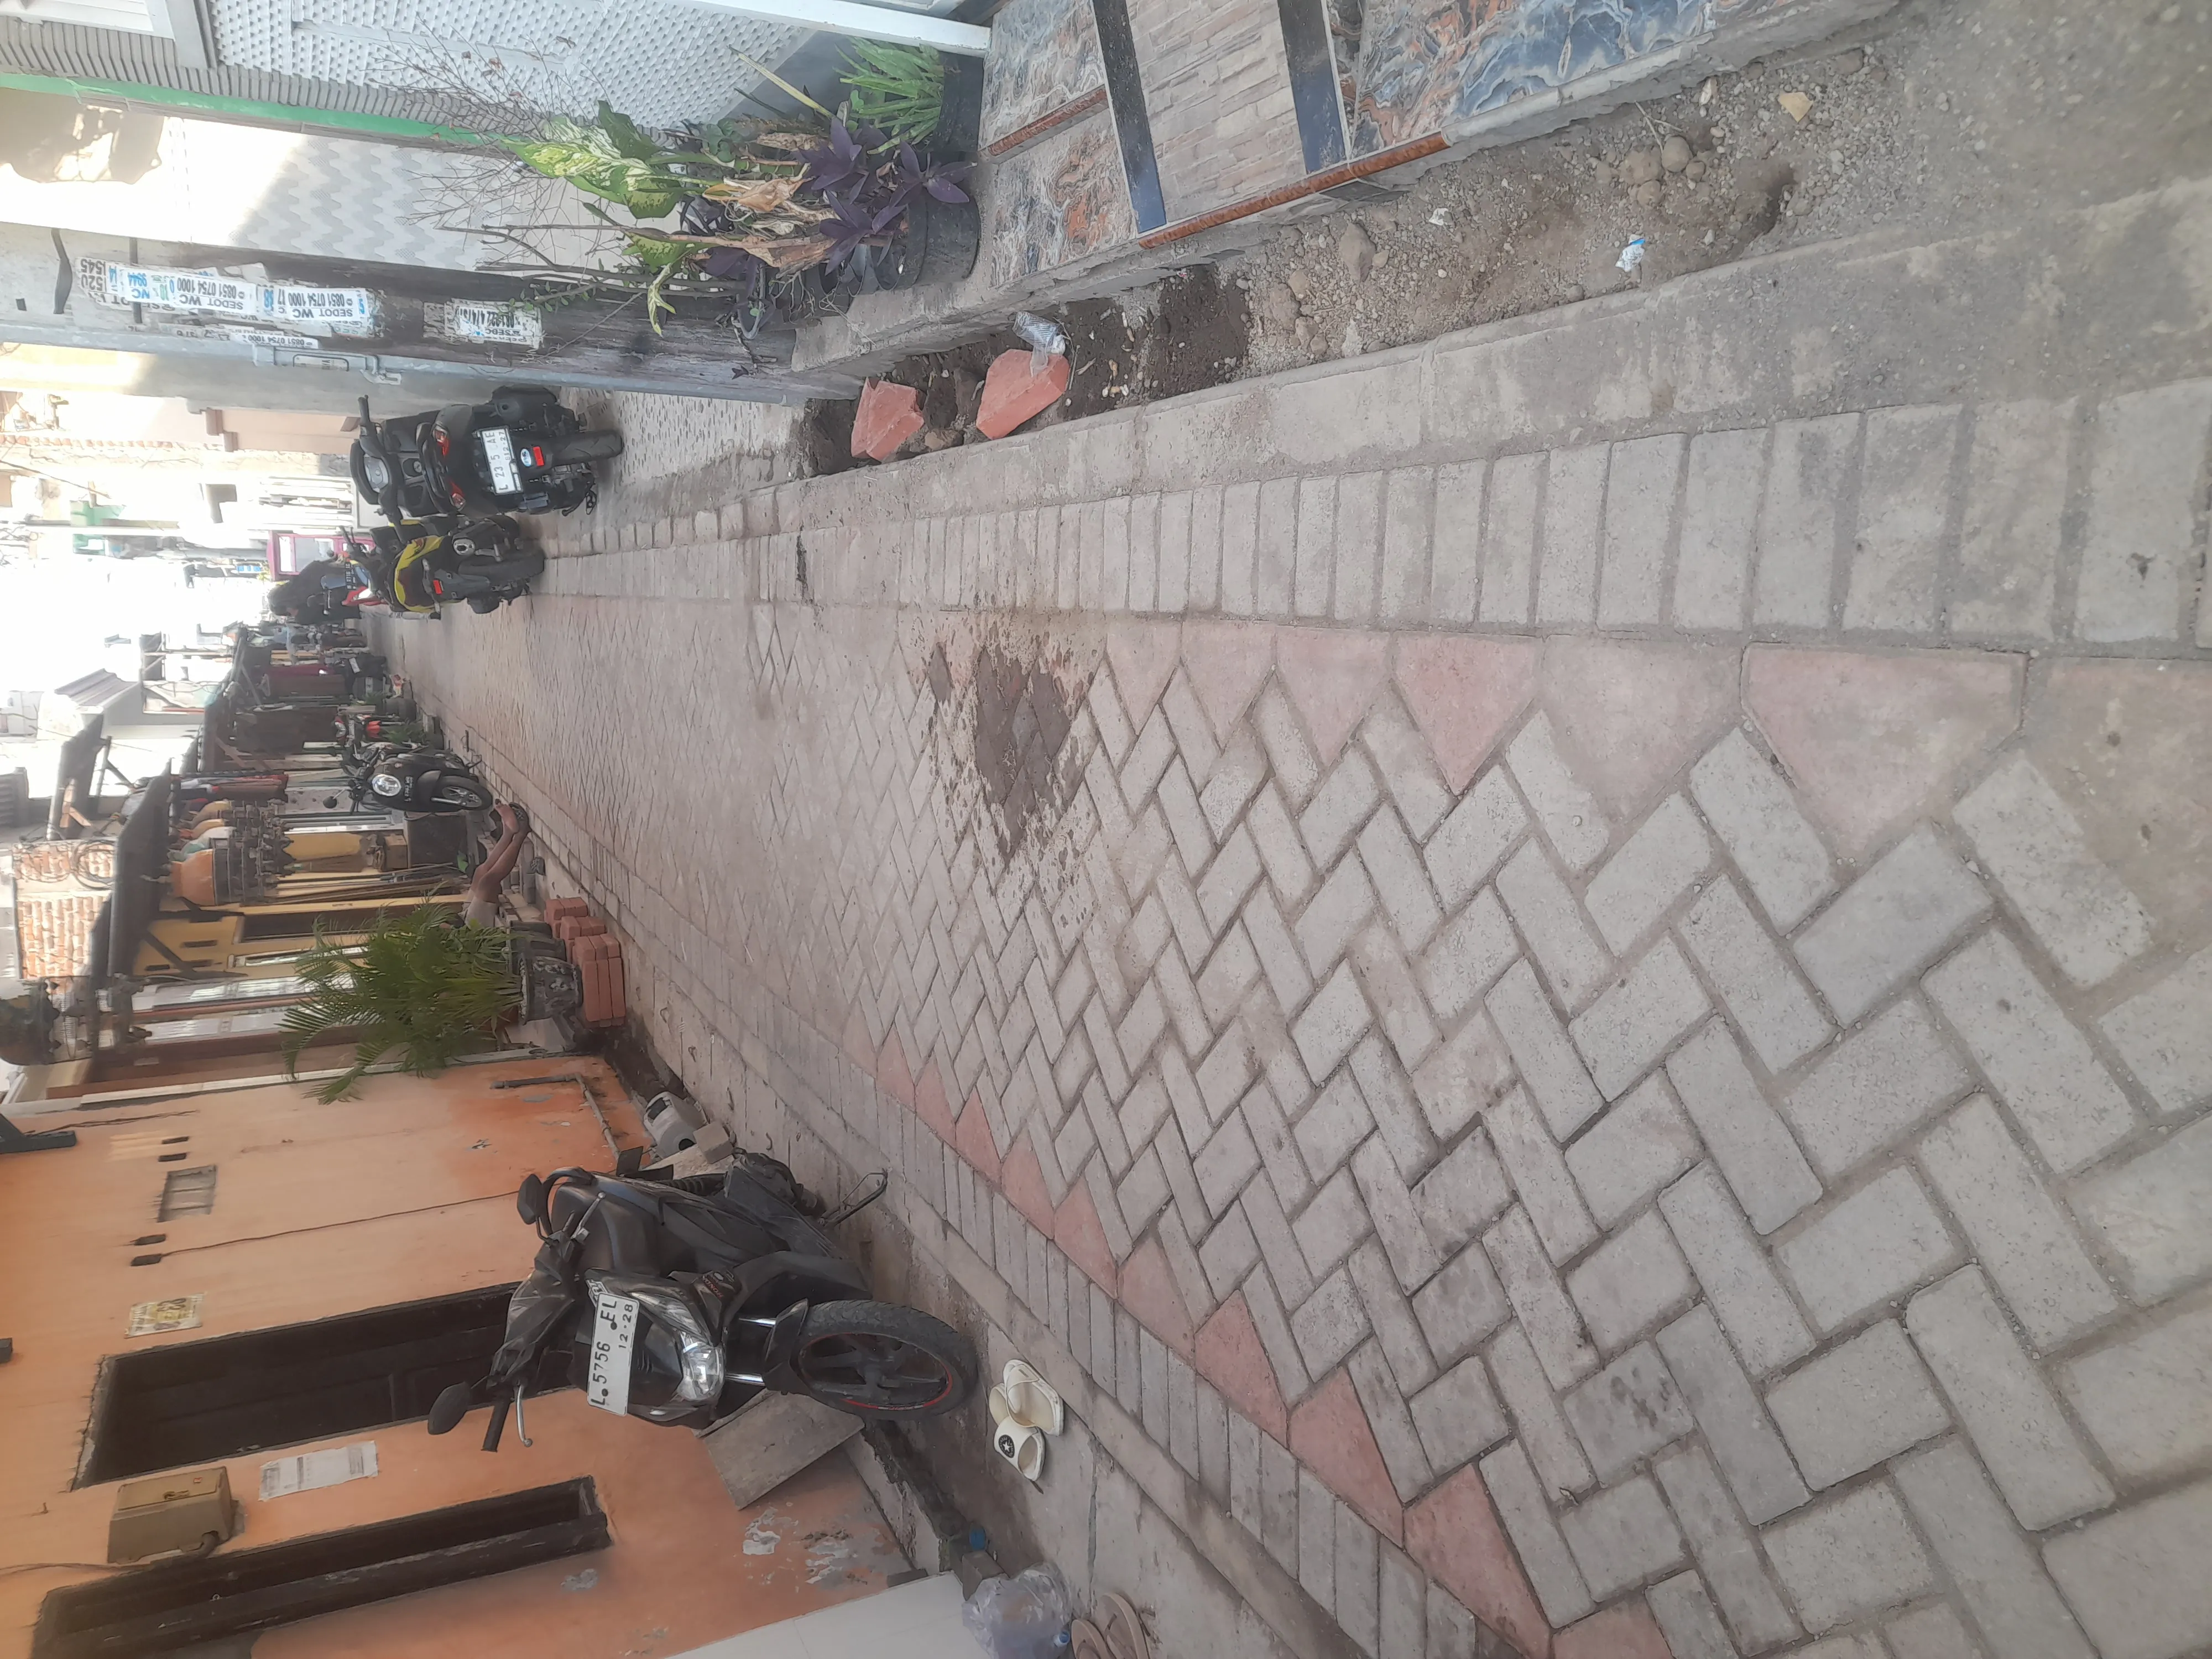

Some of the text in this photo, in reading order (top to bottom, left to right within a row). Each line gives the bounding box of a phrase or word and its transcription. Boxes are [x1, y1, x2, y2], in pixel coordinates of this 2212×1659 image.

[177, 277, 196, 293] 1000
[197, 280, 216, 296] 0754
[219, 283, 237, 299] 0851
[179, 294, 243, 310] SEDOT WC
[288, 292, 306, 306] 1000
[307, 293, 326, 307] 0754
[327, 293, 345, 307] 0851
[293, 309, 353, 318] SEDOT WC
[600, 1301, 617, 1323] EL
[593, 1341, 611, 1384] 5756
